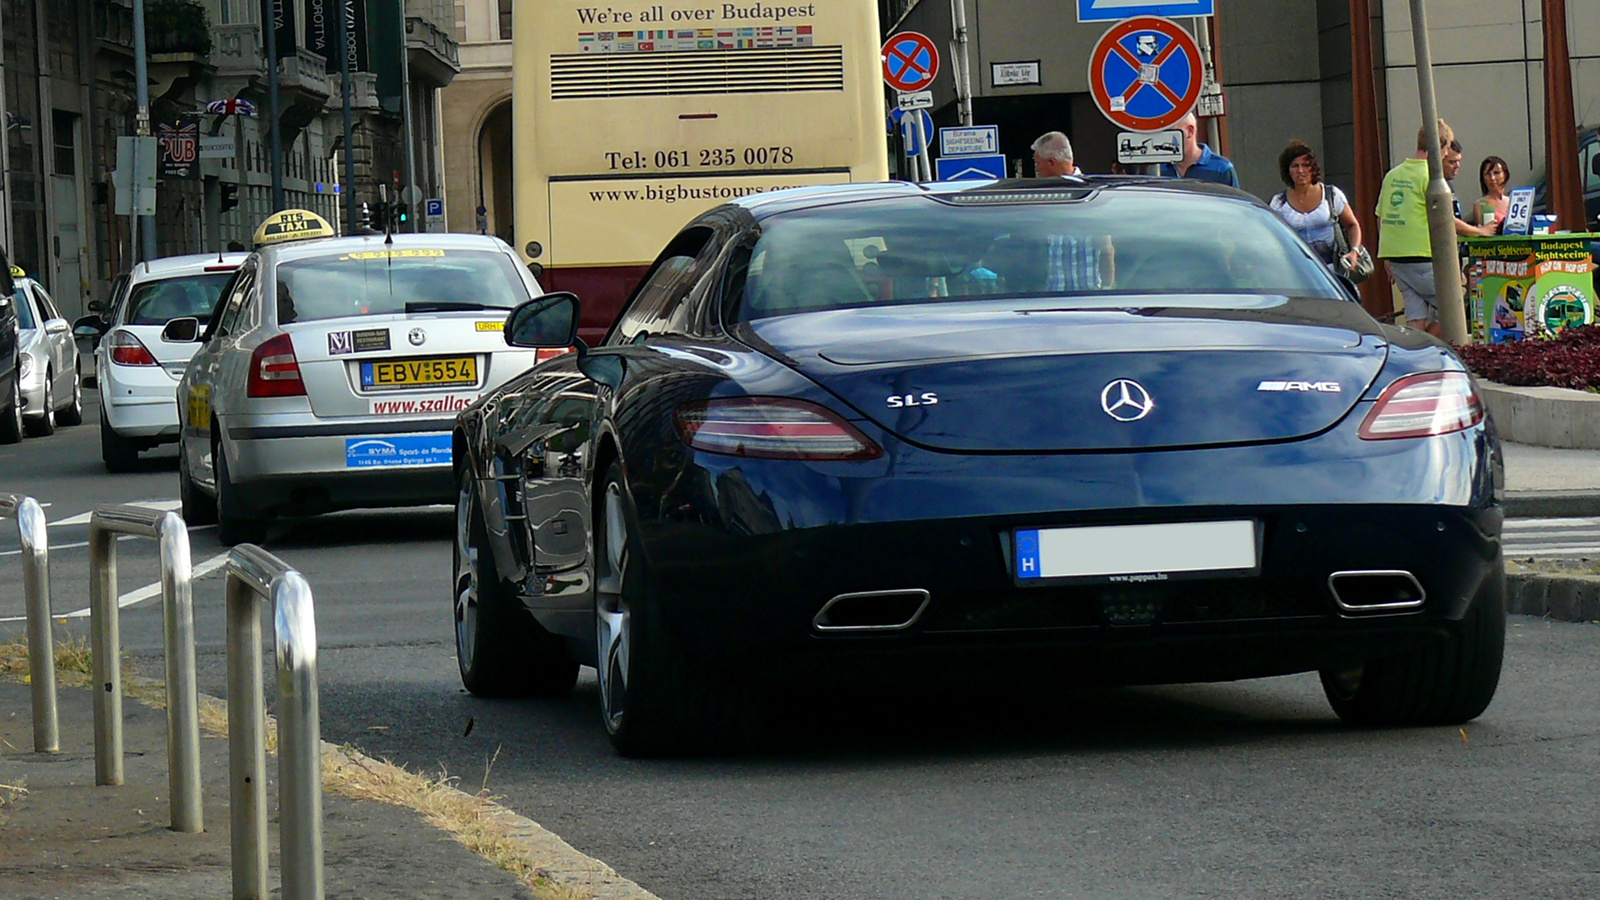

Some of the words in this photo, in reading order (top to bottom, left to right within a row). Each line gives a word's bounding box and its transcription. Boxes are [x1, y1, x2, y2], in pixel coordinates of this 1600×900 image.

[577, 7, 633, 25] We're
[640, 6, 664, 22] all
[671, 9, 715, 22] over
[721, 2, 816, 21] Budapest
[946, 137, 984, 145] SIGHTSEEING
[159, 138, 196, 162] PUB
[948, 145, 982, 153] DEPARTURE
[605, 151, 647, 170] Tel:
[654, 151, 690, 167] 061
[699, 149, 736, 166] 235
[744, 147, 794, 164] 0078
[279, 220, 307, 232] TAXI
[1540, 241, 1584, 251] Budapest
[1535, 251, 1590, 260] Sightseeing
[1540, 261, 1553, 274] HOP
[1552, 261, 1562, 271] ON
[1564, 263, 1577, 273] HOP
[1576, 263, 1588, 273] OFF
[1284, 381, 1341, 392] AMG
[886, 392, 938, 408] SLS
[368, 447, 397, 455] SYMA
[1022, 557, 1034, 571] H
